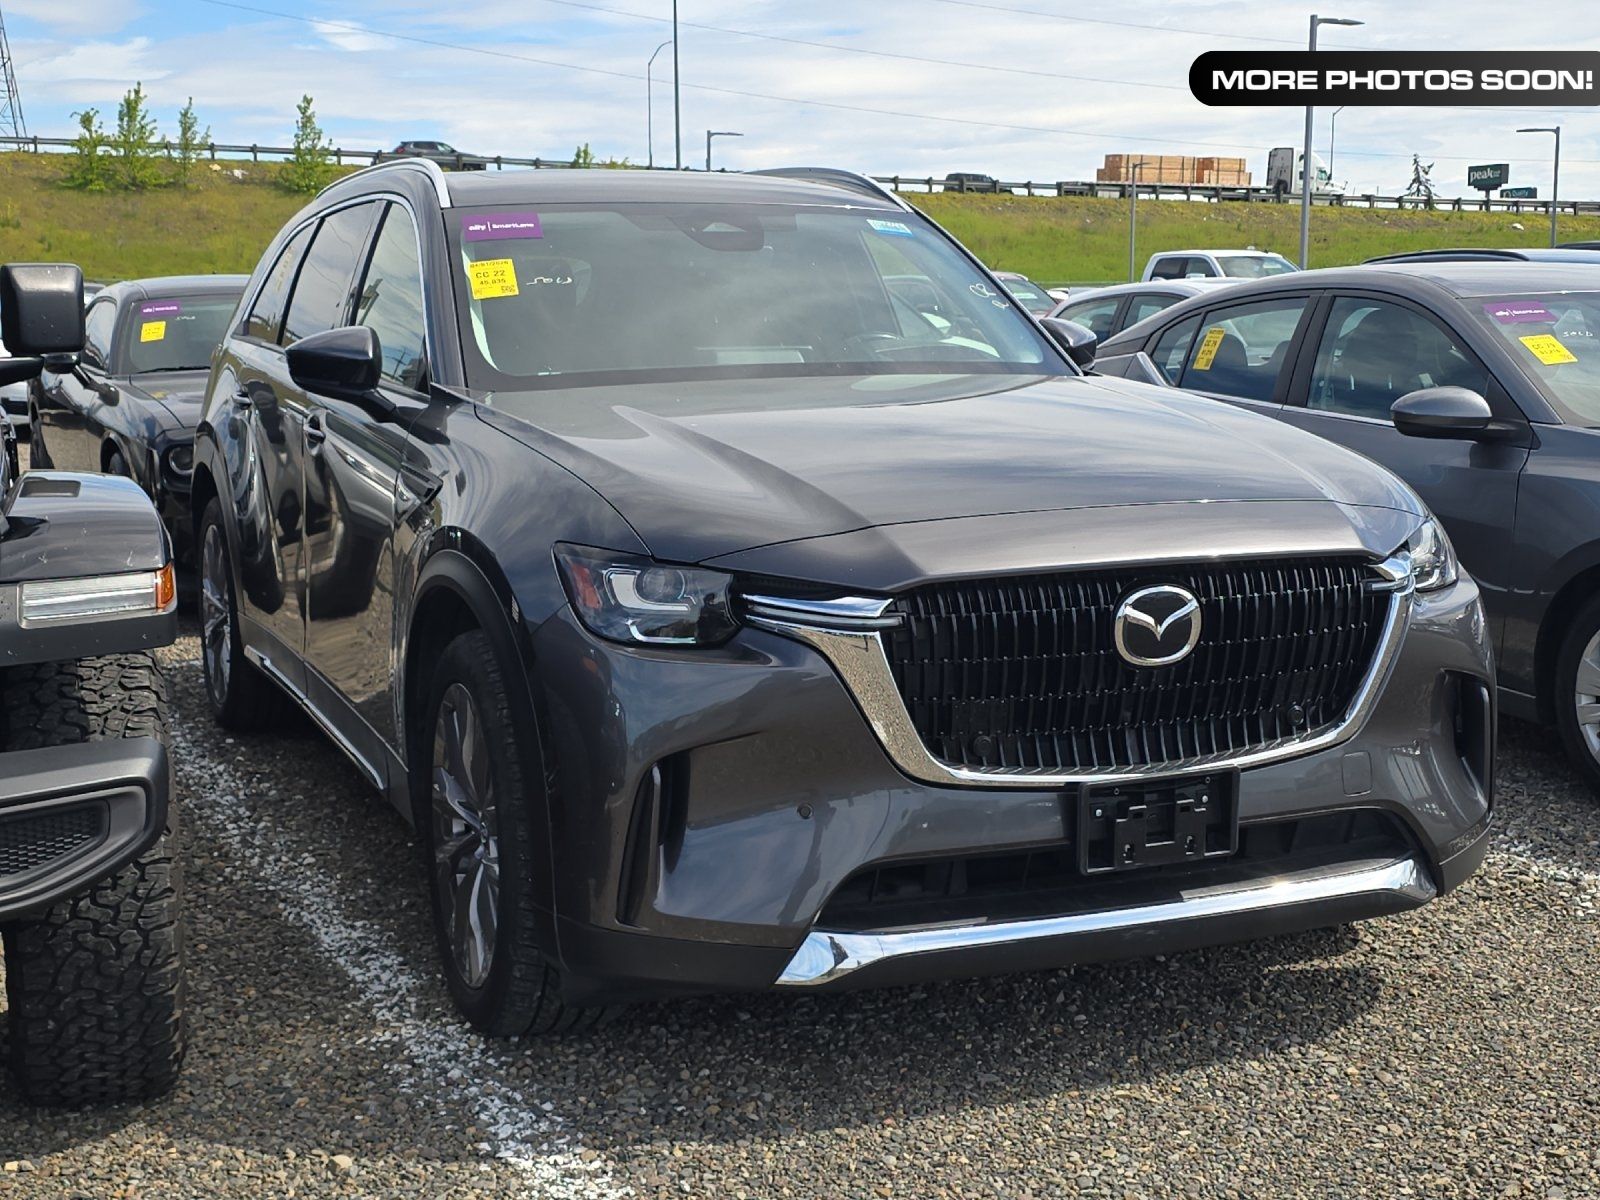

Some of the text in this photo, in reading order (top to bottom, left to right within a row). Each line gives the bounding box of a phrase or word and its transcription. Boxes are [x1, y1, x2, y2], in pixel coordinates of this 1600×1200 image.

[1470, 168, 1493, 184] peak
[475, 269, 506, 279] CC 22
